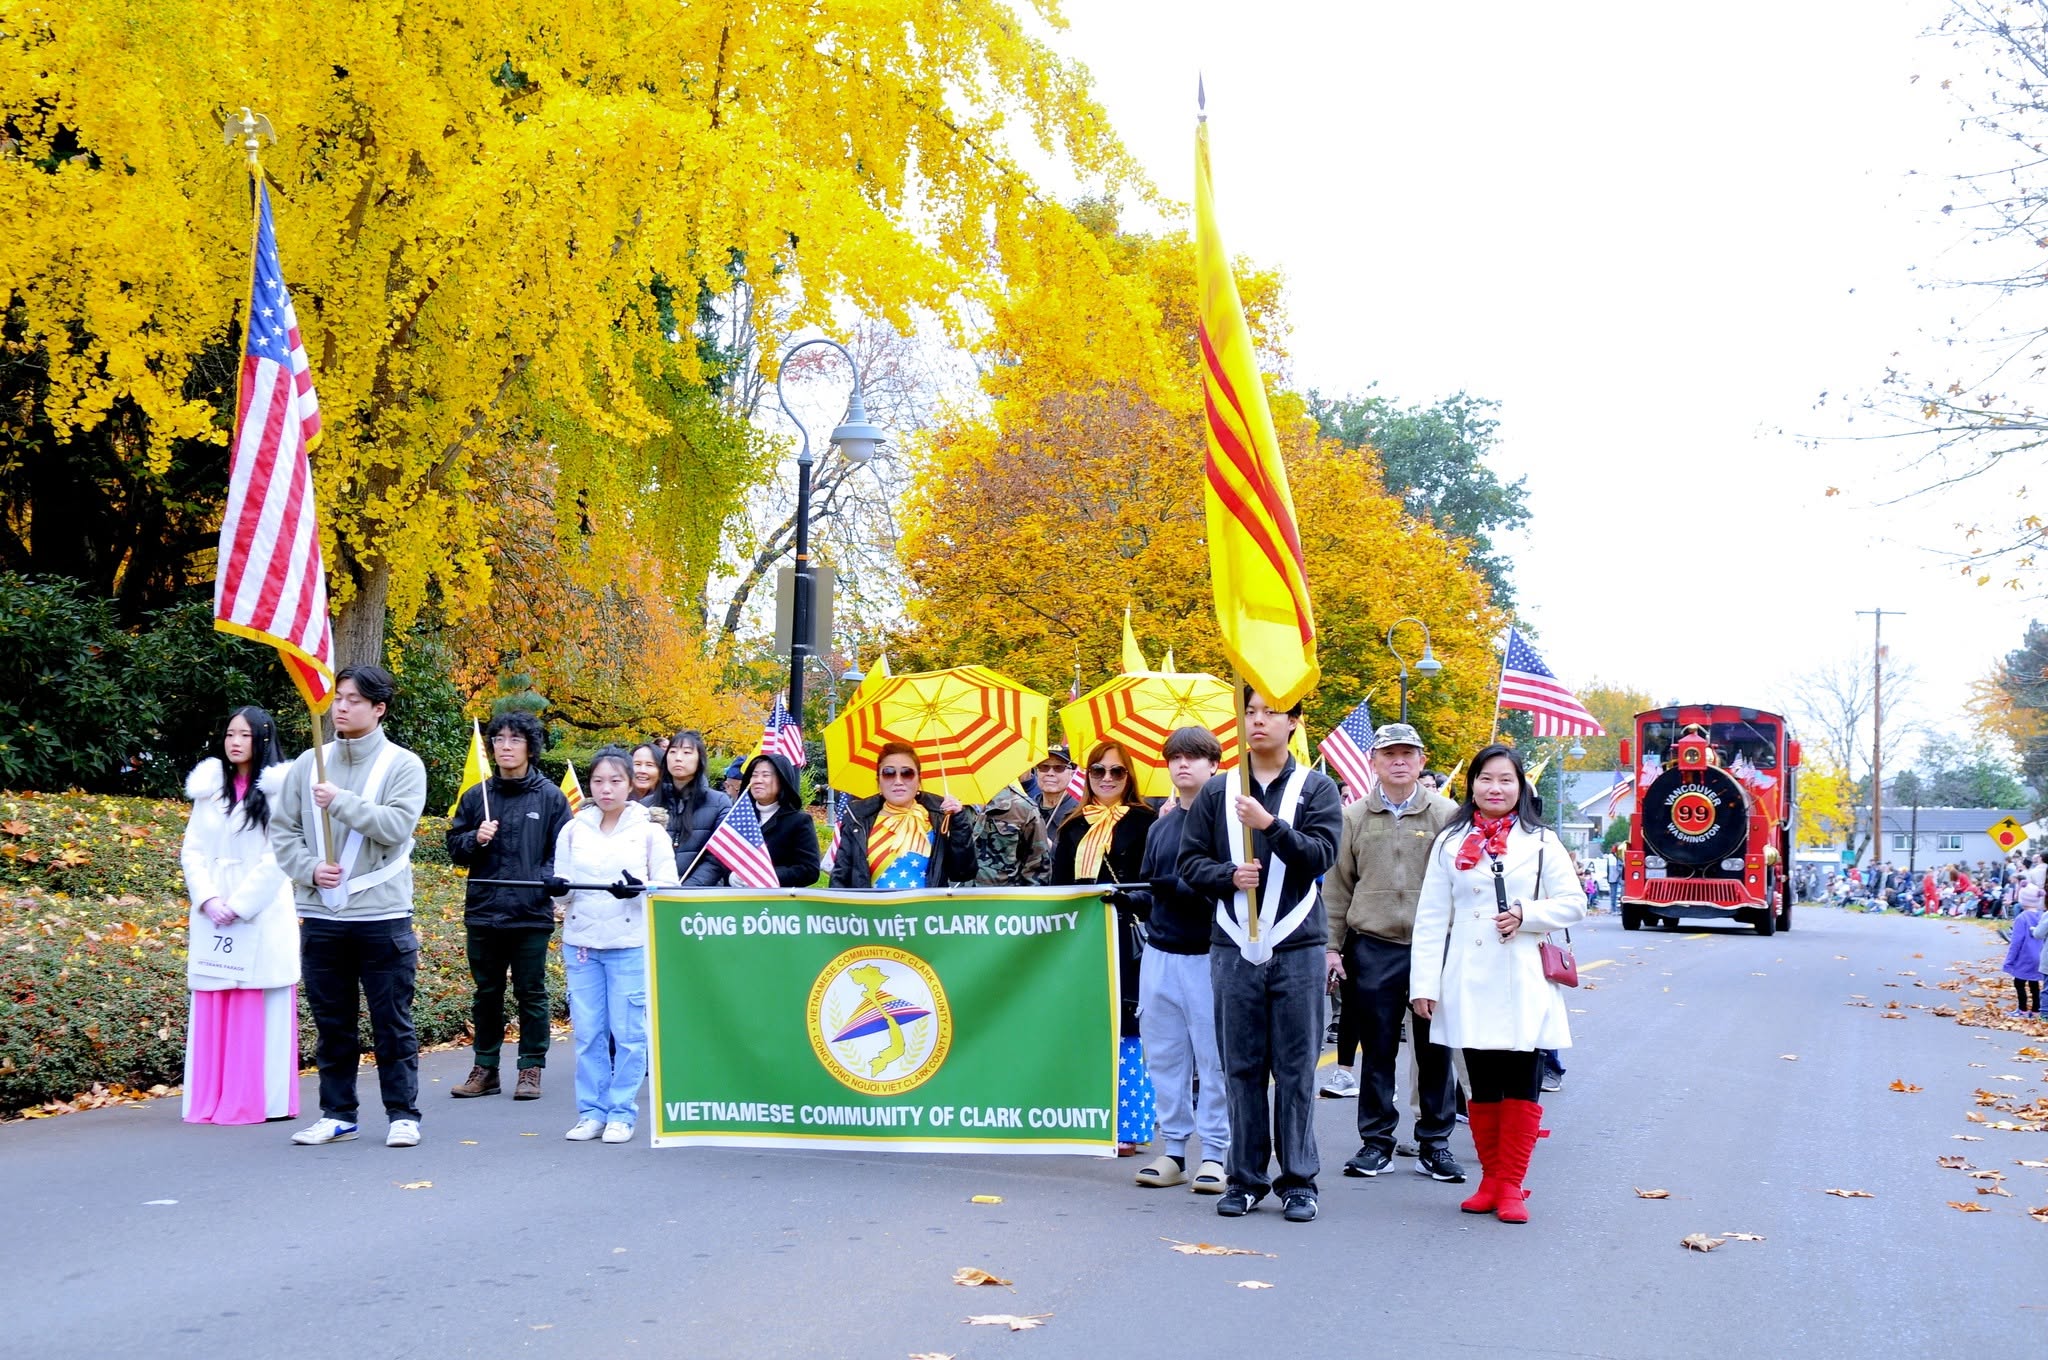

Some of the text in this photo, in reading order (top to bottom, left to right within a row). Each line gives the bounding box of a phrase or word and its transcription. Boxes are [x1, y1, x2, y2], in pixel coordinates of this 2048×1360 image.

[1664, 784, 1721, 806] VANCOUVER
[1679, 805, 1709, 823] 99
[1667, 823, 1720, 843] WASHINGTON
[680, 907, 1079, 942] CỘNG ĐỒNG NGƯỜI VIỆT CLARK COUNTY
[213, 935, 233, 954] 78
[809, 949, 949, 1024] VIETNAMESE COMMUNITY OF CLARK COUNTY
[903, 1067, 931, 1088] CLARK
[930, 1034, 948, 1067] COUNTY
[665, 1101, 1111, 1130] VIETNAMESE COMMUNITY OF CLARK COUNTY
